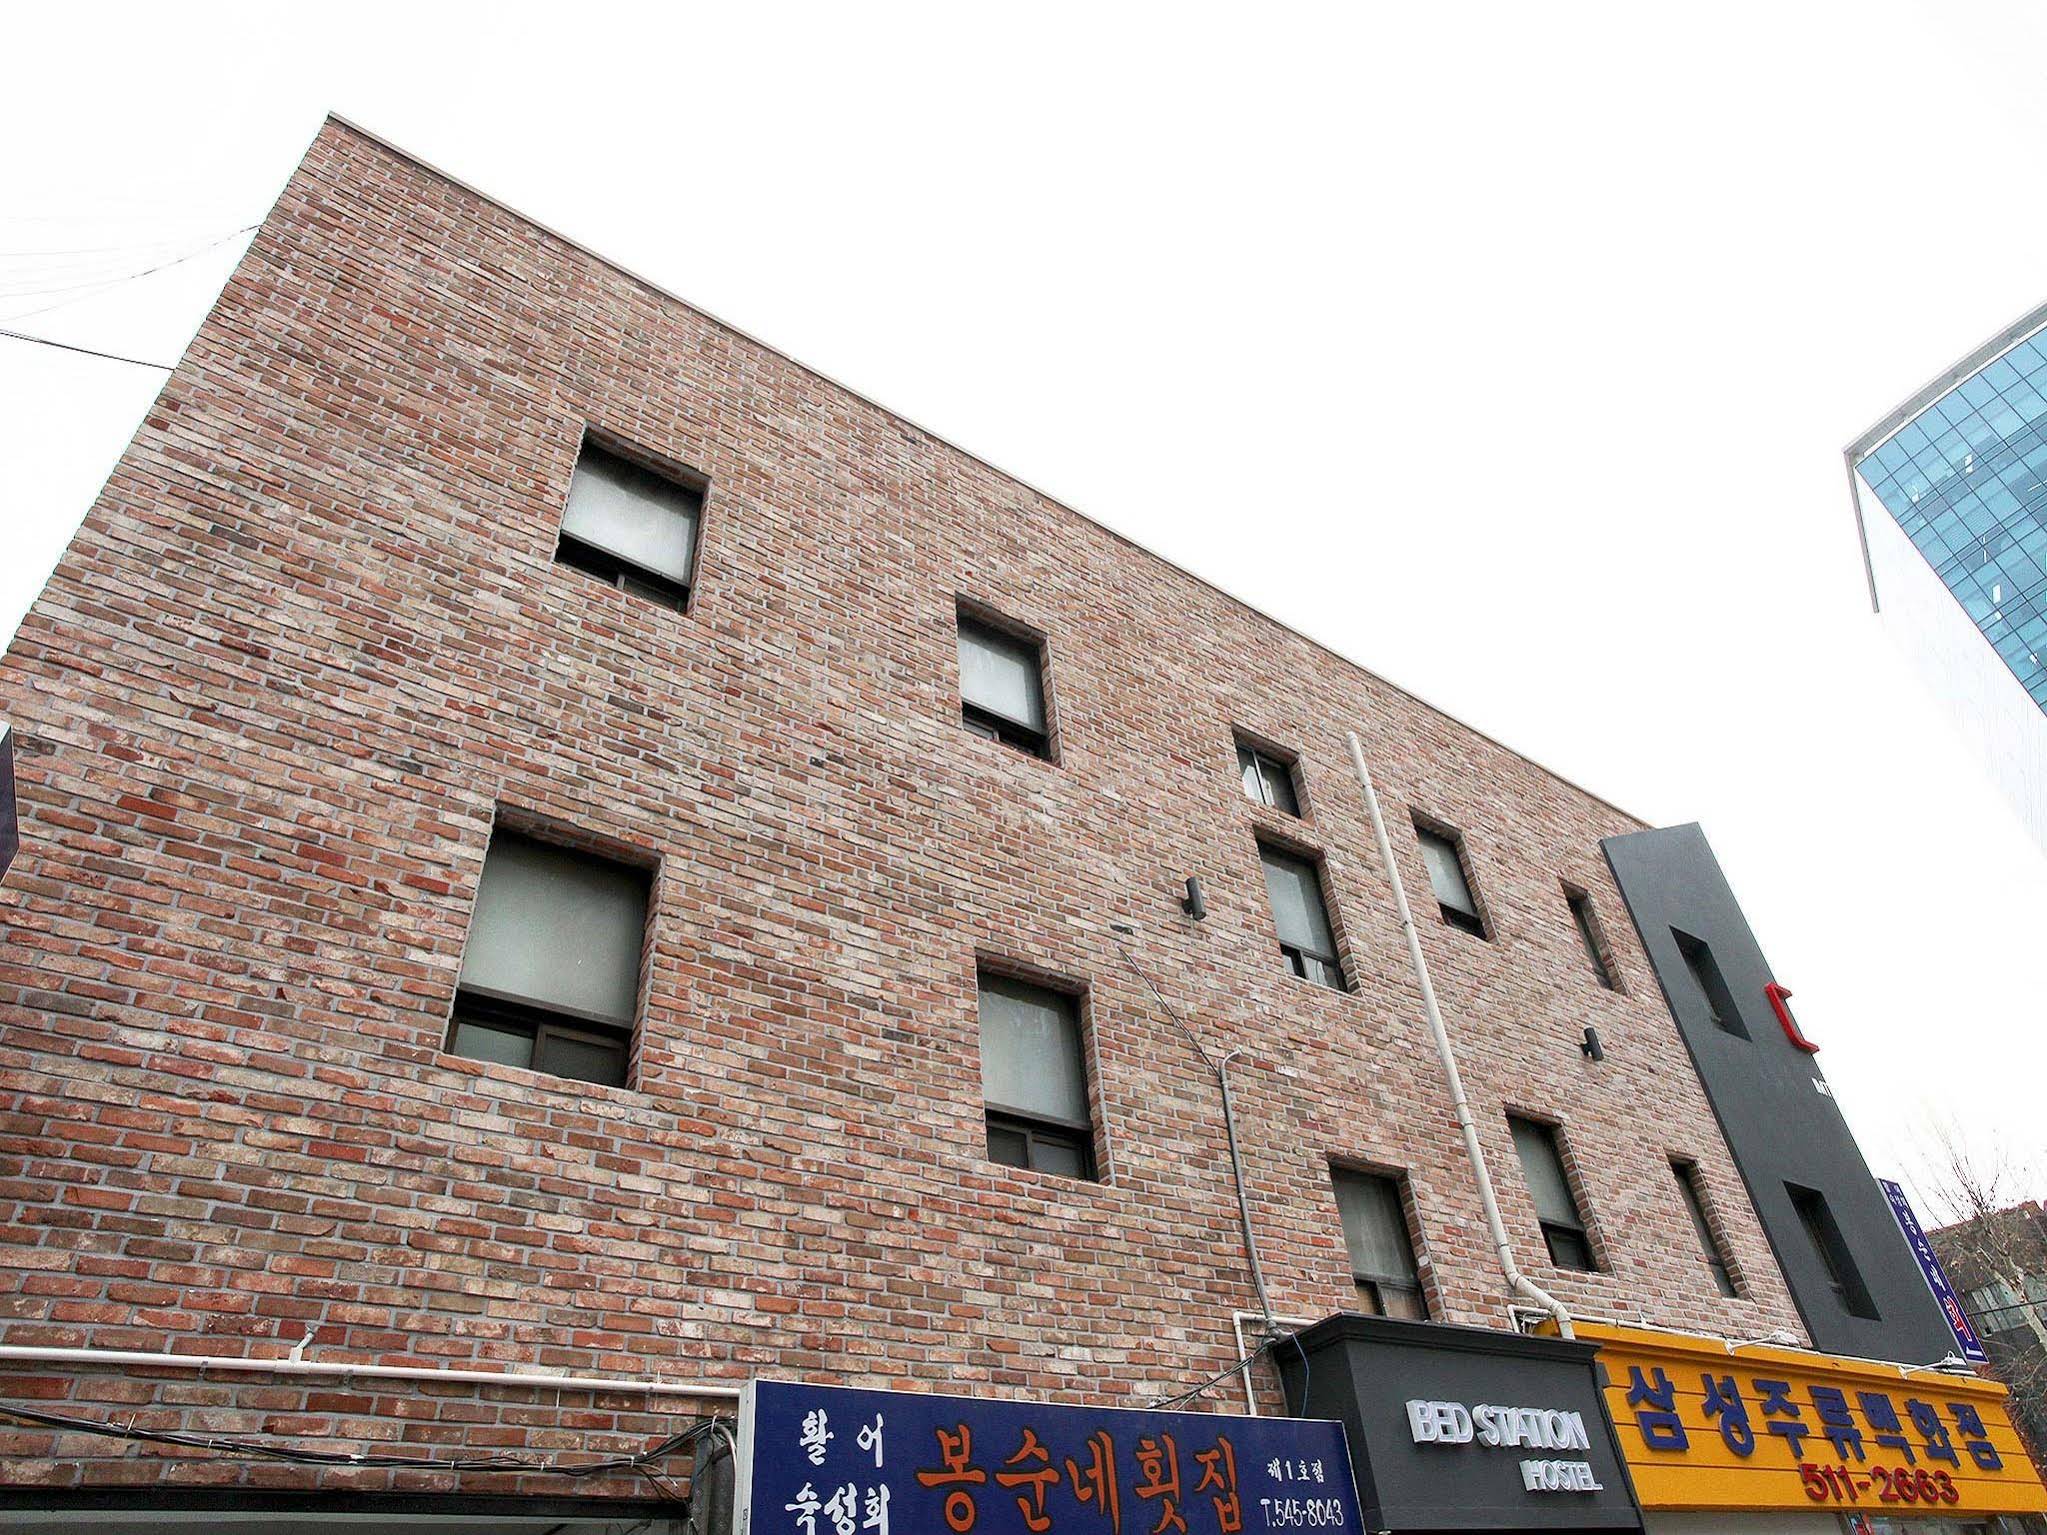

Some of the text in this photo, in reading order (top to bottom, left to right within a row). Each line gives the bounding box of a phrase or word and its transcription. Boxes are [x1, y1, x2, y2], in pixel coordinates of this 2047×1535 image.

[1405, 1399, 1591, 1451] BED STATION
[1627, 1366, 2004, 1470] 삼성주류백화점
[916, 1424, 1243, 1535] 봉순네횟집
[1519, 1459, 1604, 1492] HOSTEL
[1798, 1463, 1961, 1503] 511-2663
